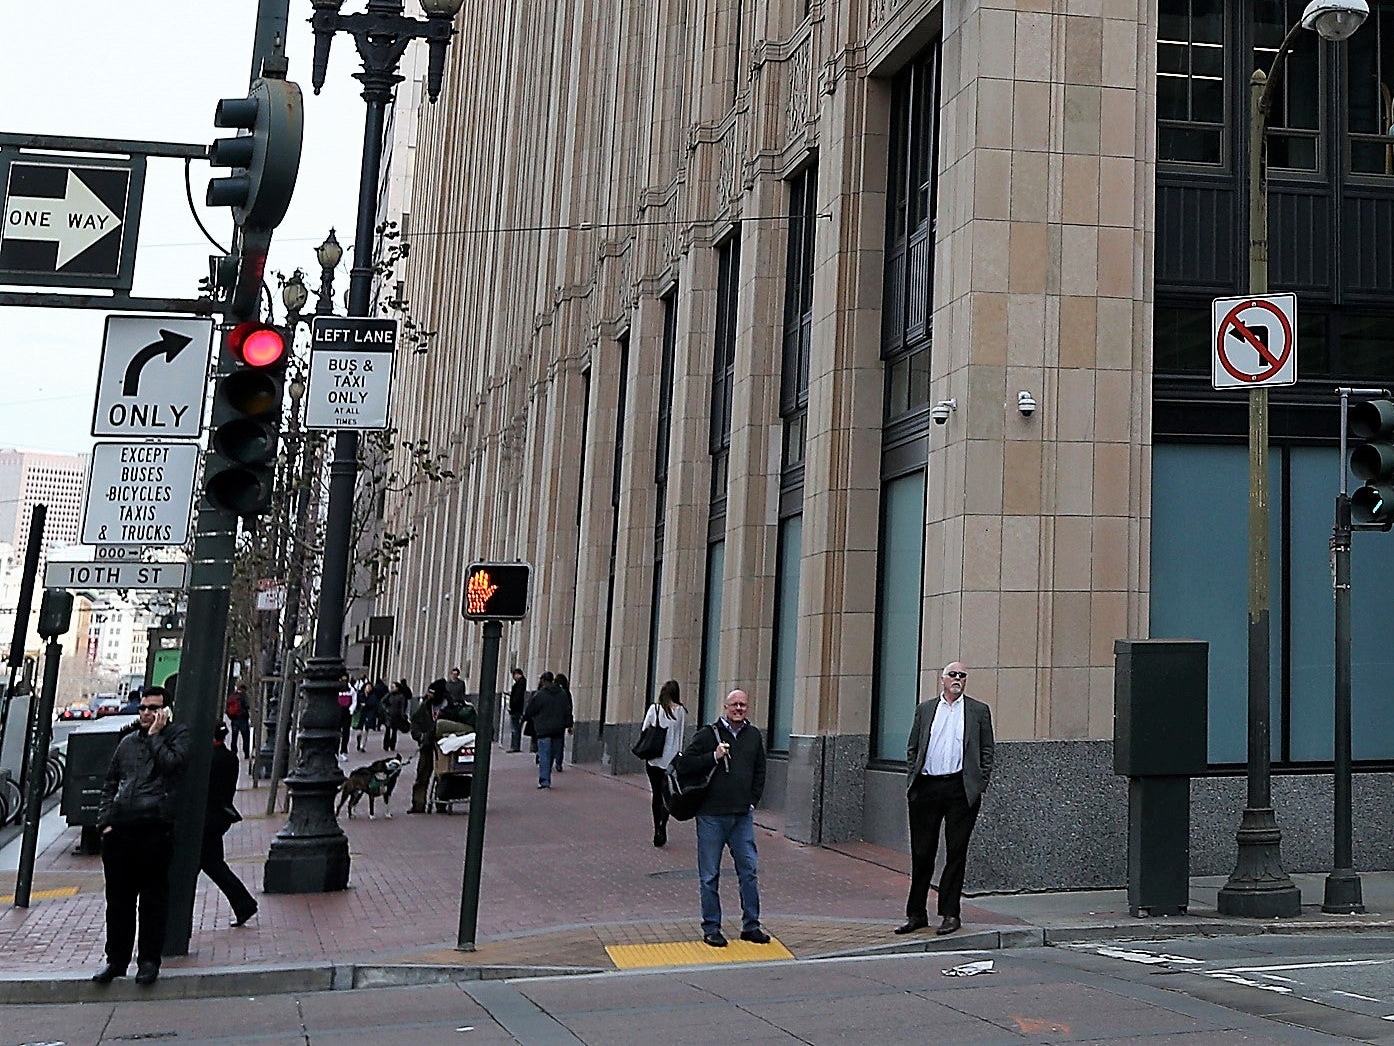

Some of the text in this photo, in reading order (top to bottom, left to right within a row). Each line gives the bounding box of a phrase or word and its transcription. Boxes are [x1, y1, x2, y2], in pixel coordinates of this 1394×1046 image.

[9, 210, 110, 230] ONE WAY
[315, 328, 394, 344] LEFT LANE
[328, 358, 374, 372] BUS &
[333, 375, 366, 388] TAXI
[327, 391, 369, 404] ONLY
[109, 403, 189, 428] ONLY
[334, 407, 360, 415] AT ALL
[335, 418, 358, 426] TIMES
[120, 447, 170, 463] EXCEPT
[121, 466, 164, 482] BUSES
[108, 486, 172, 502] BICYCLES
[119, 505, 157, 521] TAXIS
[98, 525, 172, 541] & TRUCKS
[69, 567, 163, 583] 10TH ST
